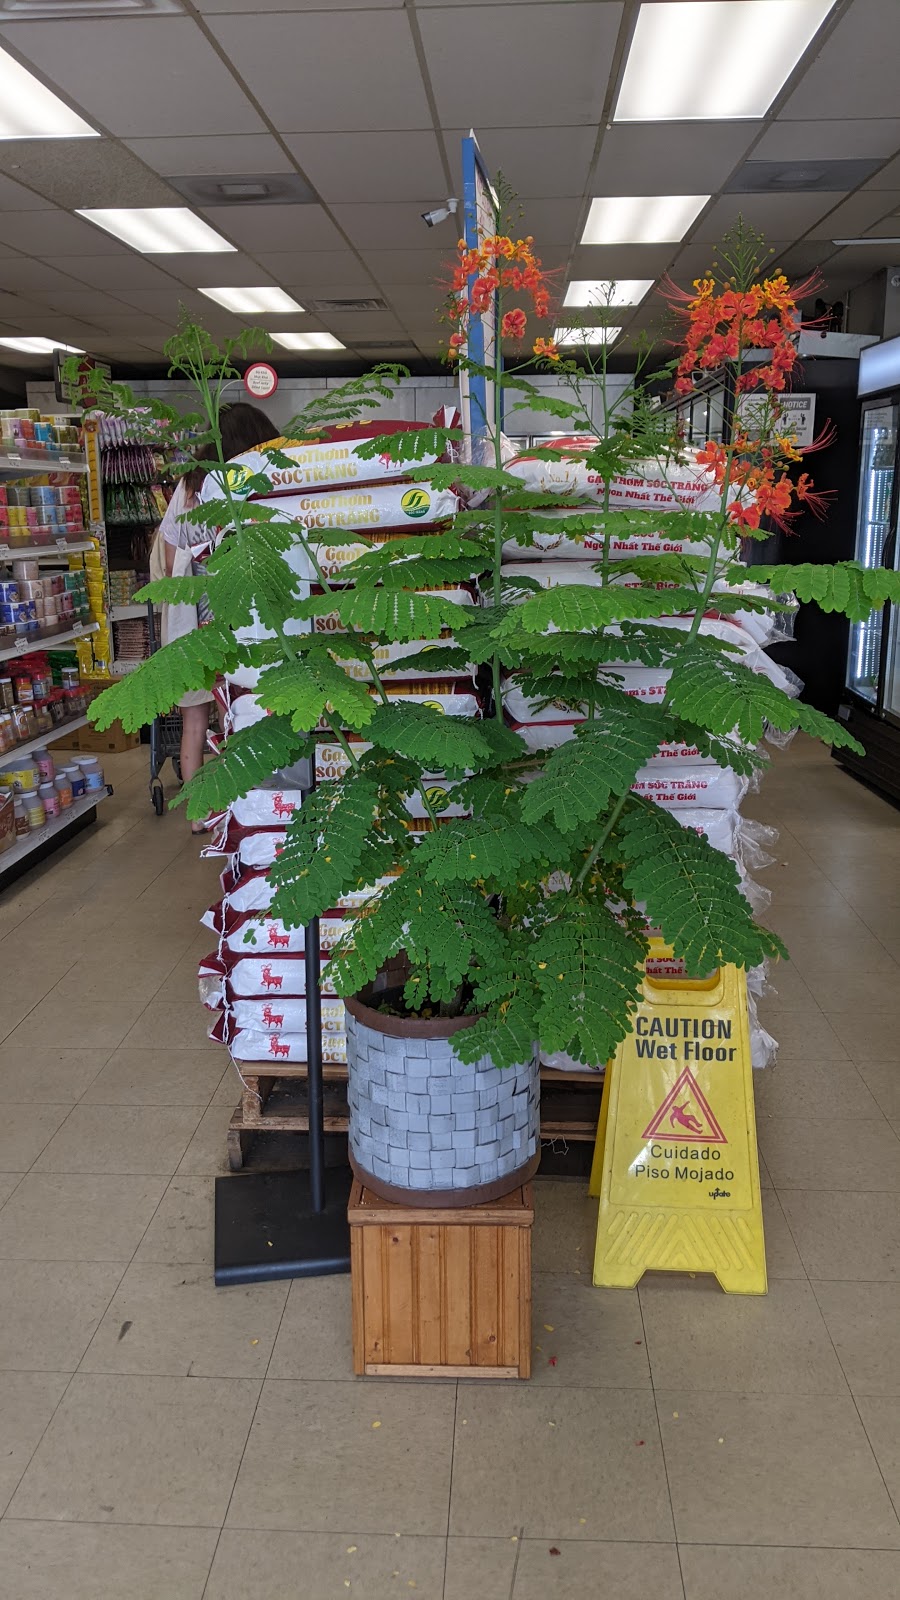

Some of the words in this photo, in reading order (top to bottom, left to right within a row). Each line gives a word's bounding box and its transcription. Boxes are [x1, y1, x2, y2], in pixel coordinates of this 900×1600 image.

[783, 400, 808, 409] NOTICE
[587, 475, 606, 486] GẠ
[597, 488, 622, 498] Non
[625, 490, 650, 501] Nhất
[584, 540, 610, 551] Ngo
[614, 541, 639, 551] Nhất
[642, 542, 661, 552] Thế
[663, 543, 683, 553] Giới
[660, 748, 678, 757] Thế
[656, 792, 676, 801] Thế
[677, 792, 696, 801] Giới
[646, 966, 663, 974] hất
[665, 966, 682, 974] Thế
[636, 1016, 732, 1039] CAUTION
[635, 1039, 678, 1061] Wet
[684, 1041, 737, 1062] Floor
[650, 1144, 721, 1161] Cuidado
[635, 1164, 670, 1179] Piso
[675, 1166, 735, 1183] Mojado
[708, 1187, 731, 1200] update
